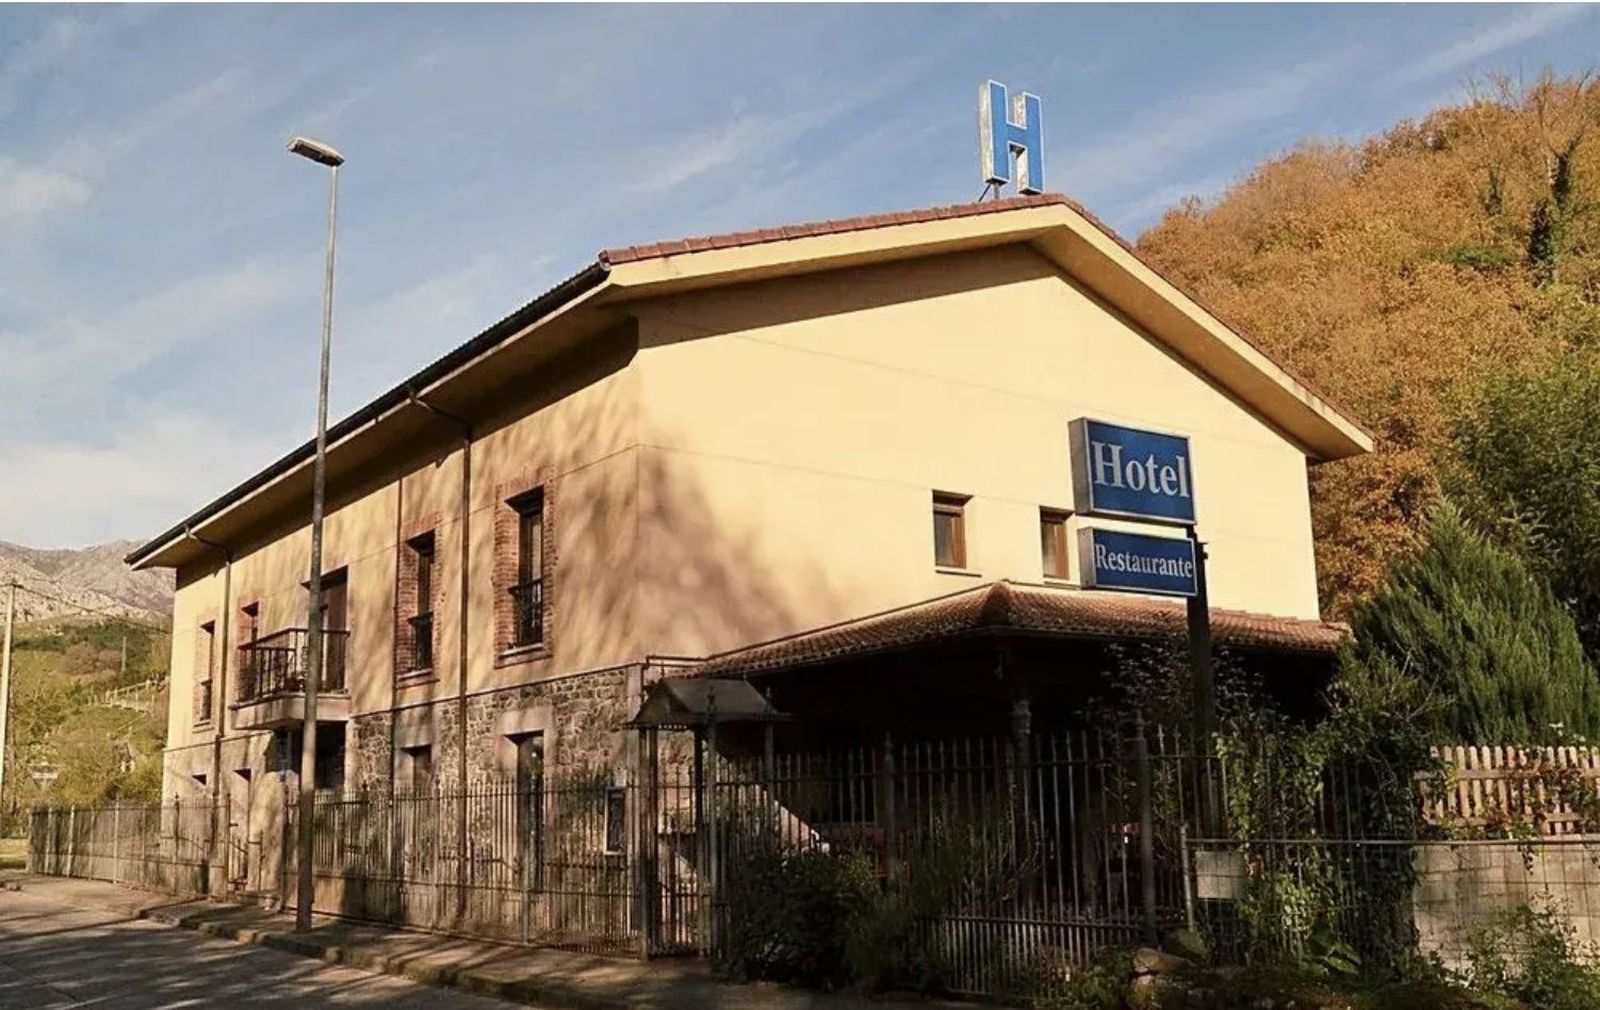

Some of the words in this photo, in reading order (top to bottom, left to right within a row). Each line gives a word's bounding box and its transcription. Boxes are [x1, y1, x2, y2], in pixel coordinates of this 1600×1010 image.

[987, 79, 1044, 193] H
[1091, 441, 1190, 498] Hotel
[1094, 543, 1193, 578] Restaurante
